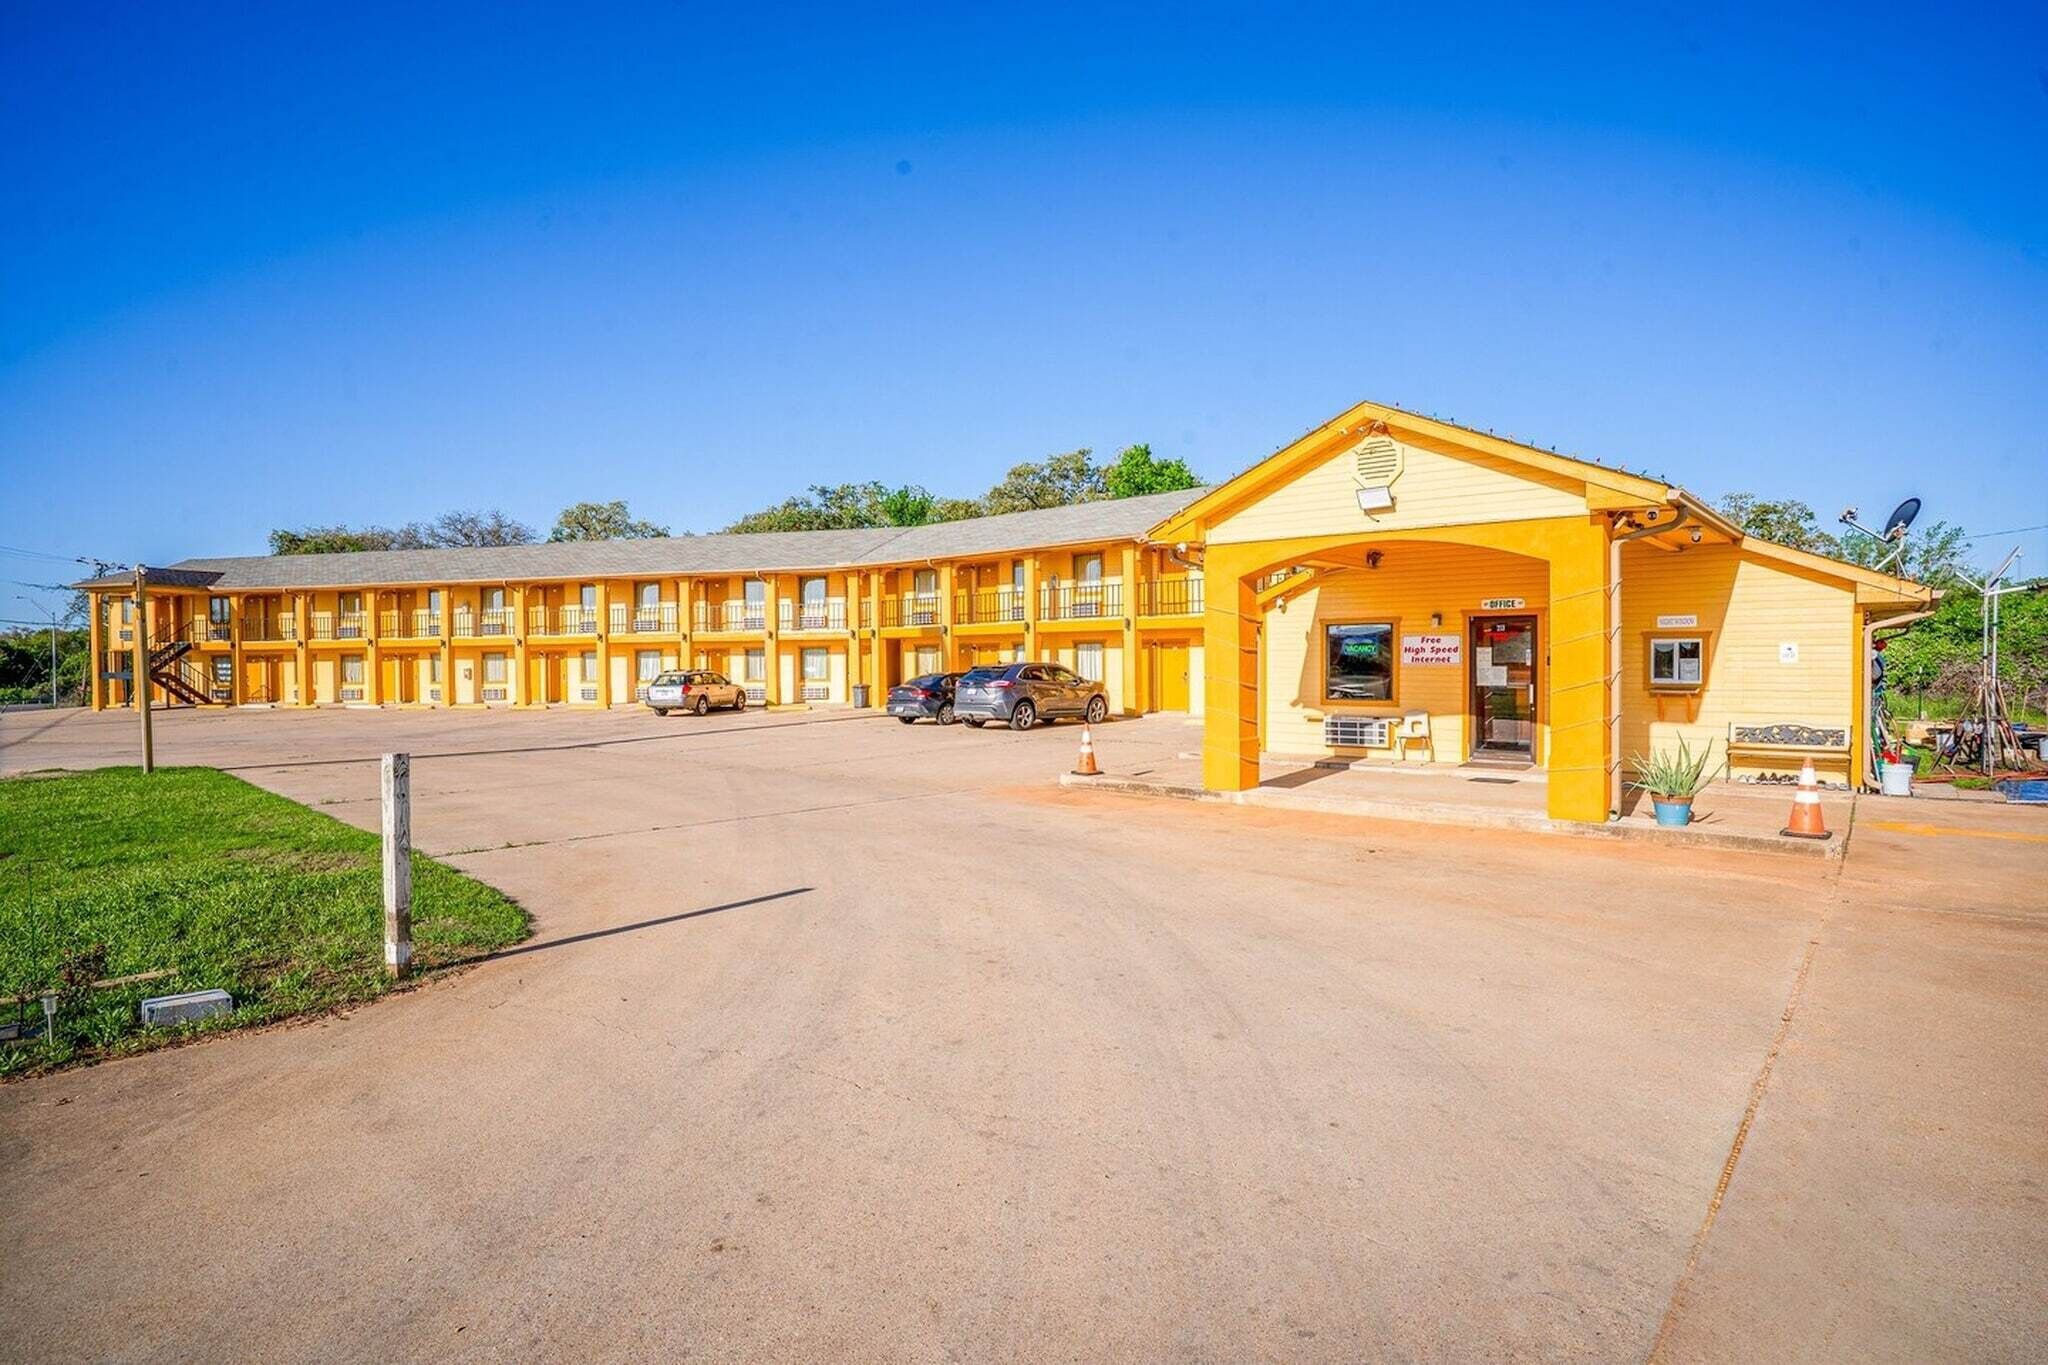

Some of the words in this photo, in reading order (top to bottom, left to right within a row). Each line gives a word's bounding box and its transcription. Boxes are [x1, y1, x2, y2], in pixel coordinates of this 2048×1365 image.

[1489, 600, 1516, 608] OFFICE
[1404, 646, 1426, 655] High
[1430, 646, 1459, 655] Speed
